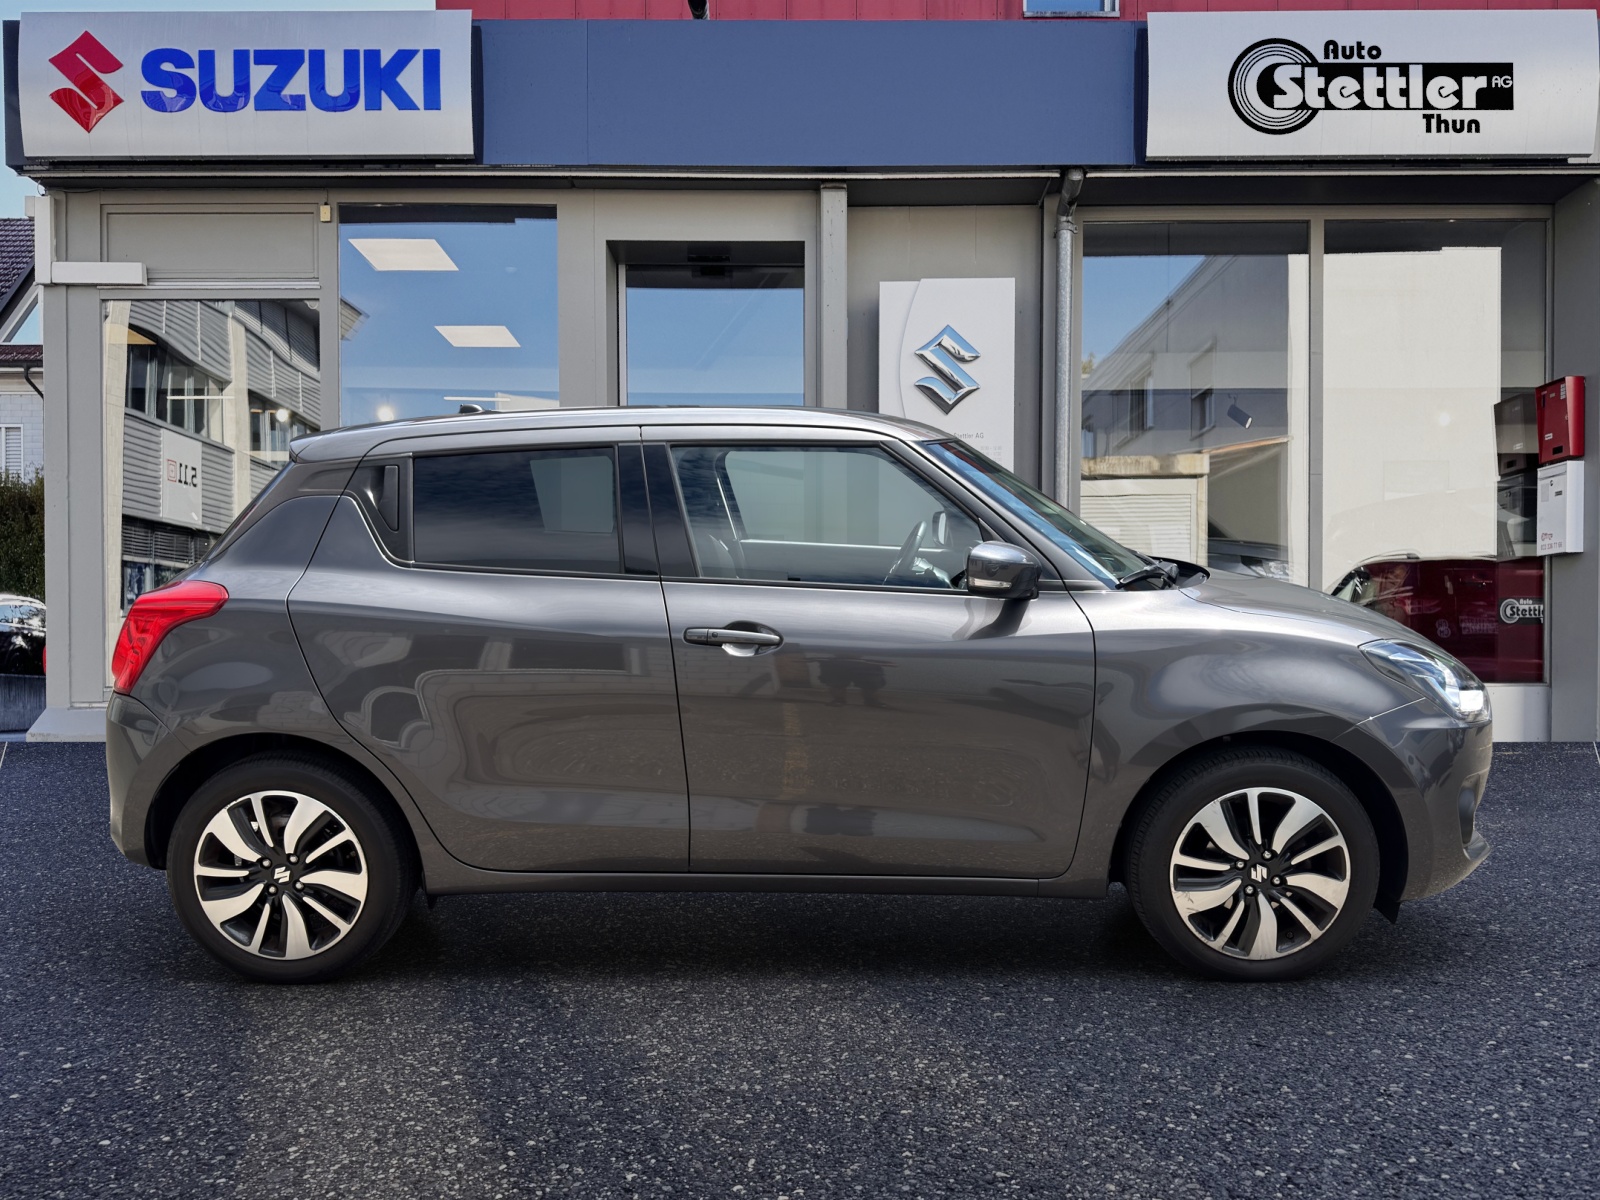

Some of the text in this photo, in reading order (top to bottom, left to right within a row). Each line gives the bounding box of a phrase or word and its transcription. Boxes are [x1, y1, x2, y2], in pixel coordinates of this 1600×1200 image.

[1323, 39, 1382, 60] Auto
[140, 47, 442, 113] SUZUKI
[1273, 63, 1513, 109] Stettler AG
[1422, 113, 1481, 133] Thun
